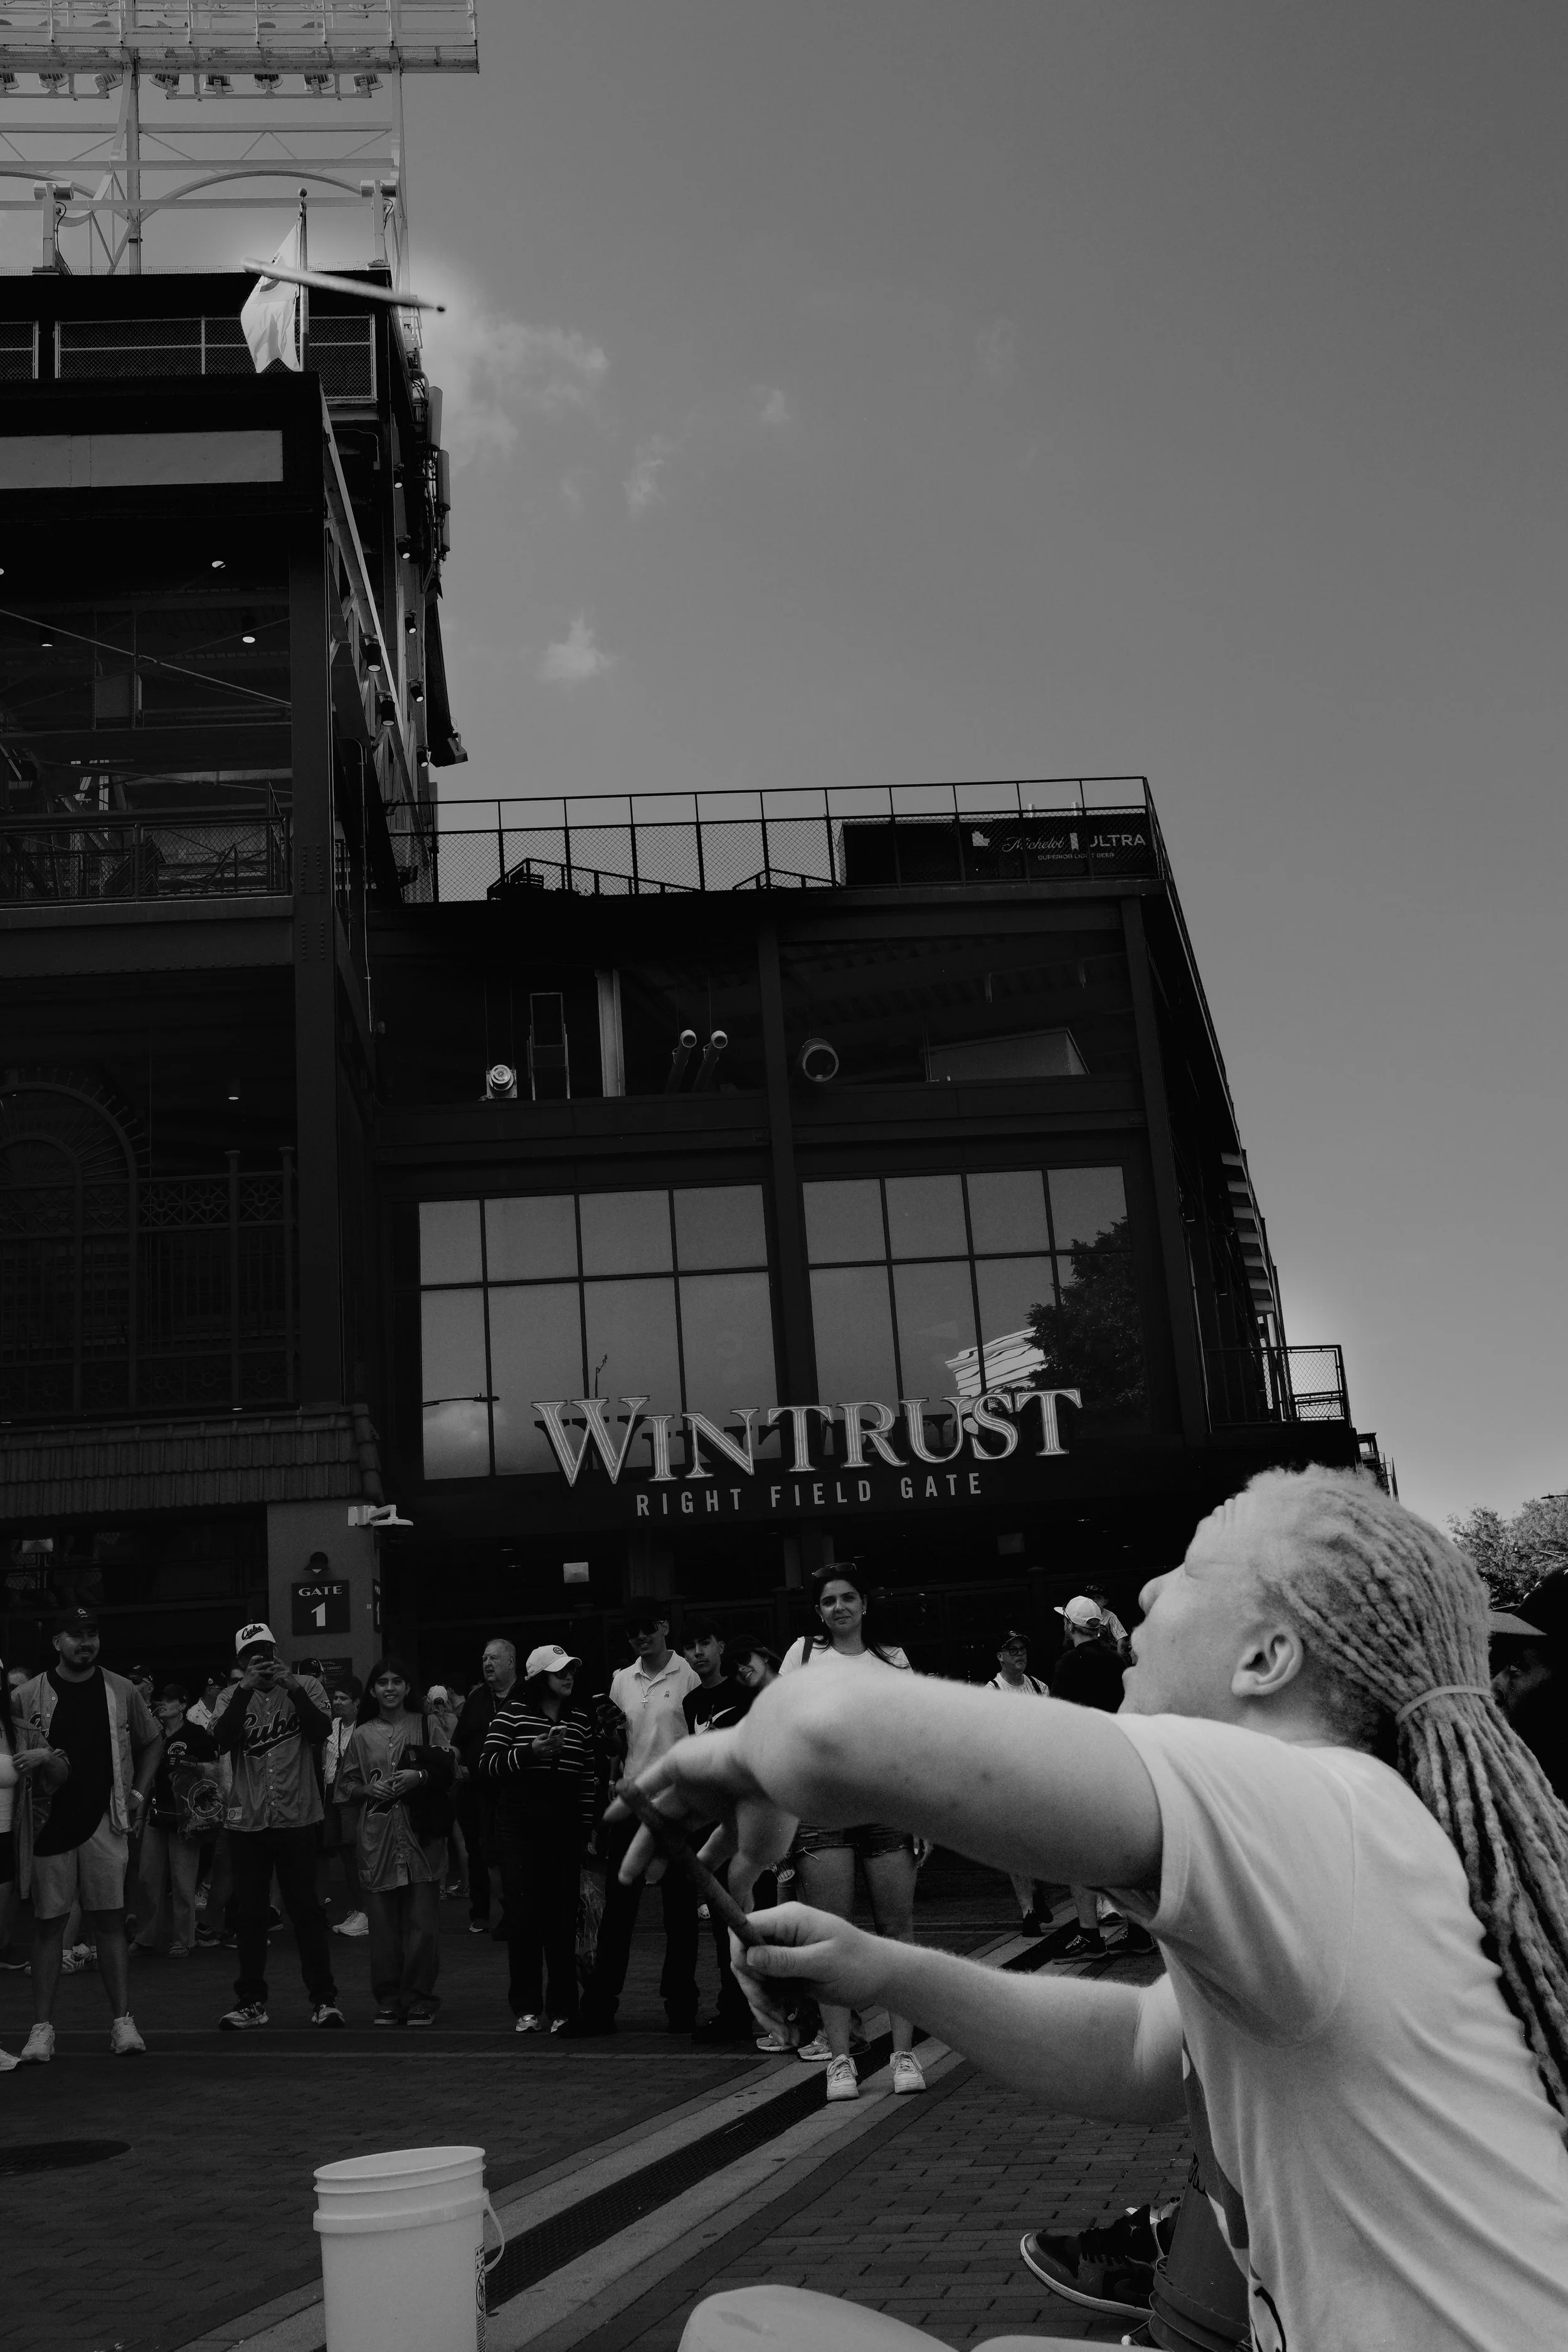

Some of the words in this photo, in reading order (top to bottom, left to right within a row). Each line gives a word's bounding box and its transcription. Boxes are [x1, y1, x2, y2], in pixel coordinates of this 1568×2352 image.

[531, 1387, 1084, 1488] WINTRUST
[636, 1487, 744, 1517] RIGHT
[771, 1479, 874, 1508] FIELD
[900, 1472, 983, 1499] GATE
[298, 1585, 343, 1596] GATE
[311, 1602, 326, 1627] 1
[241, 1624, 264, 1641] Cubs
